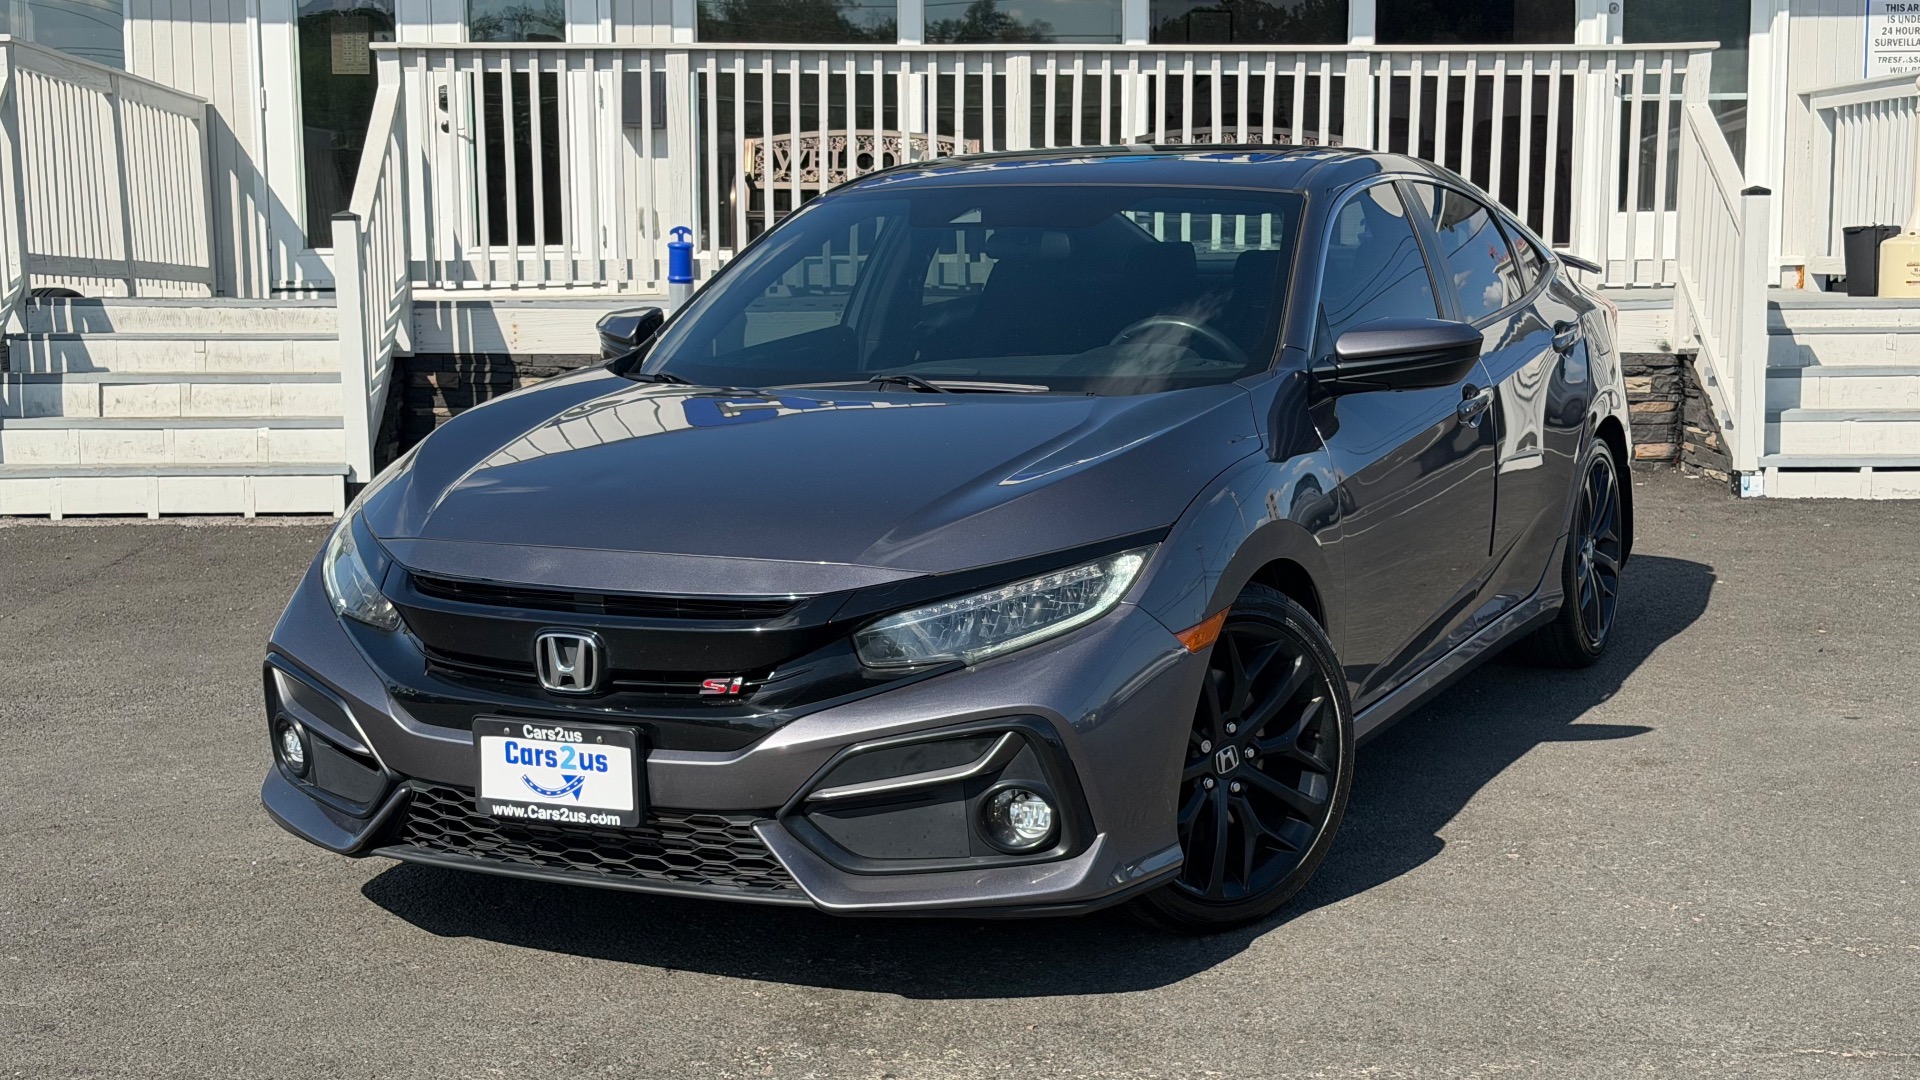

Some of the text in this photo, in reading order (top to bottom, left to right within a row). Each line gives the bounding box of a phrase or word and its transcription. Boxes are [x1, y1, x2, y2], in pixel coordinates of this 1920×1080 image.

[1885, 3, 1906, 12] THIS
[1887, 15, 1896, 24] IS
[1882, 26, 1920, 36] 24 HOUR
[522, 724, 584, 743] Cars2us
[504, 740, 609, 773] Cars2us
[491, 803, 621, 827] www.Cars2us.com
